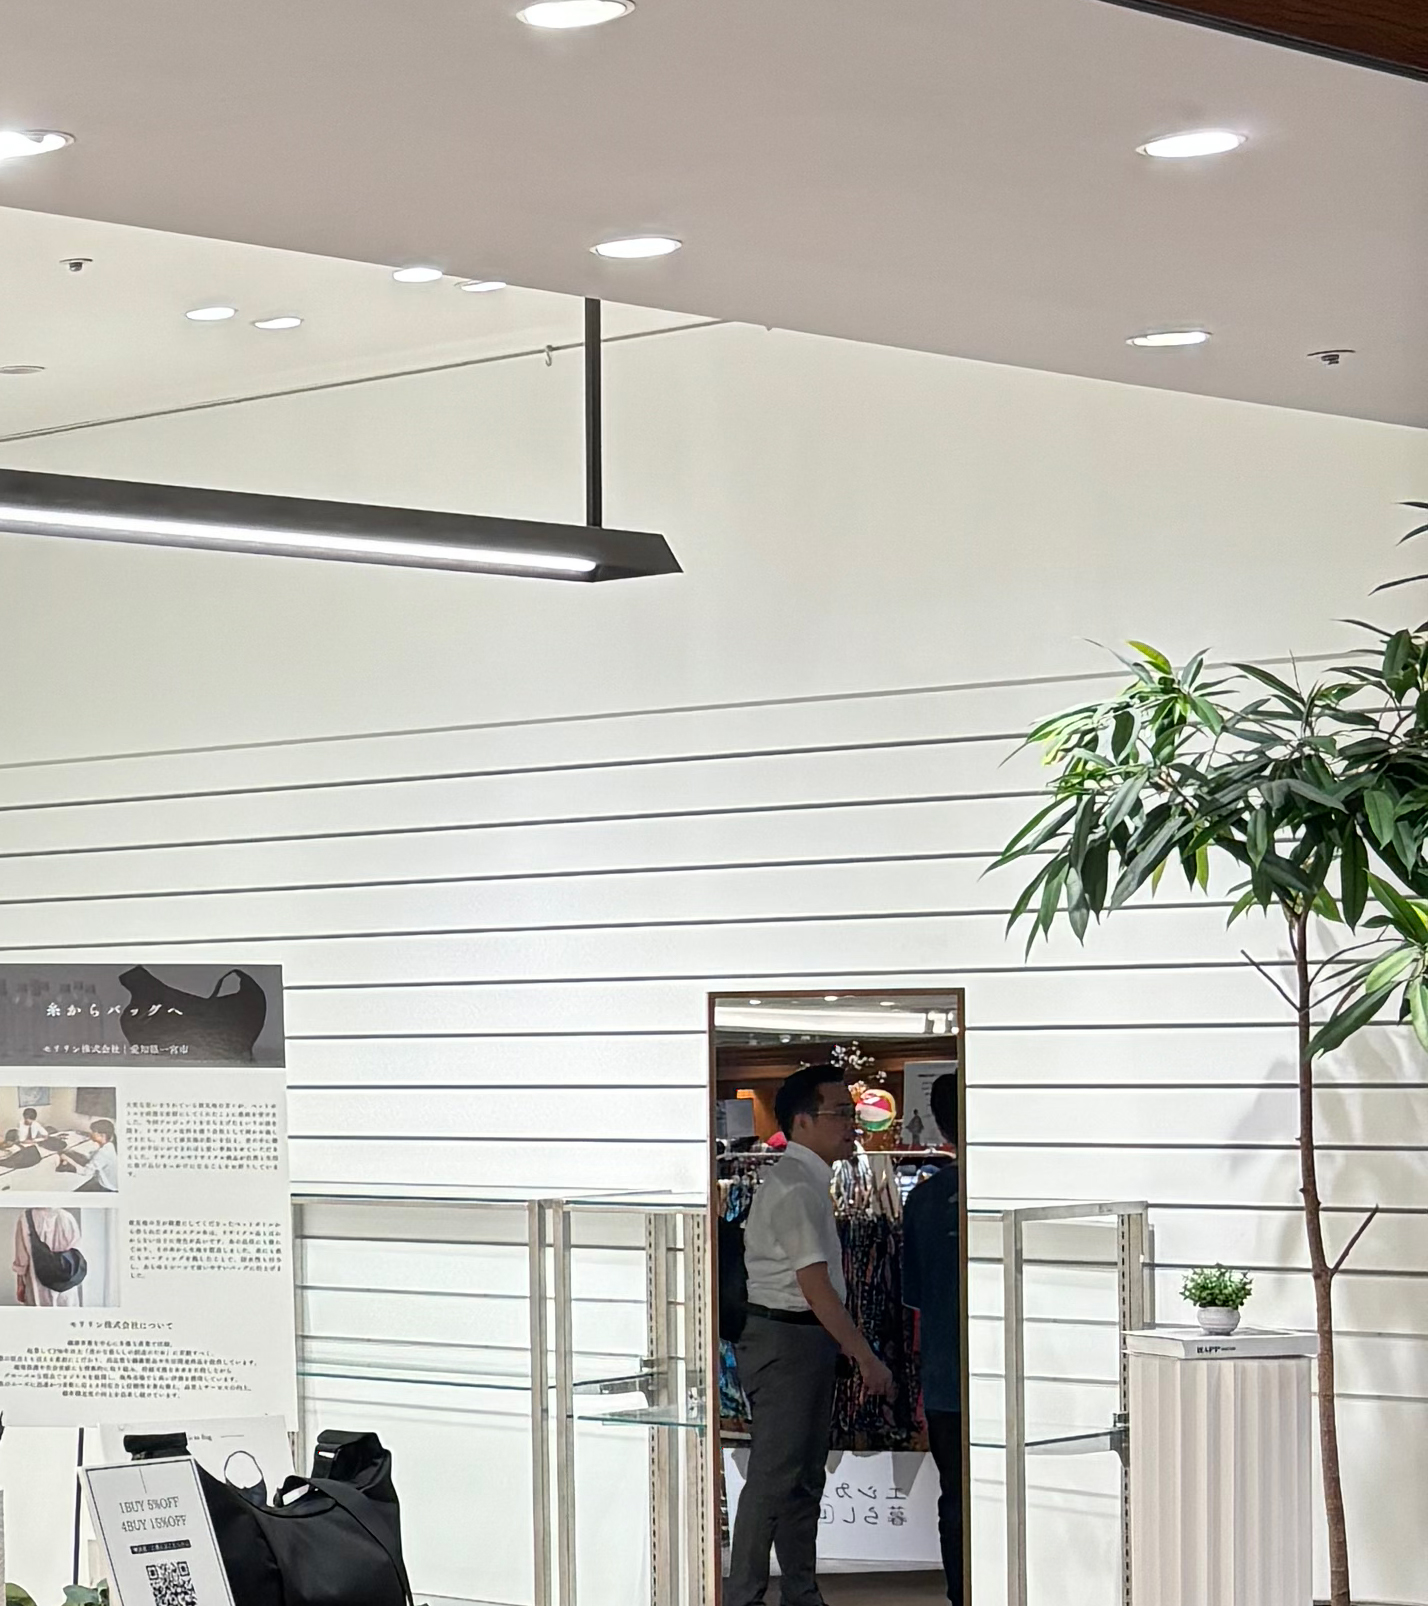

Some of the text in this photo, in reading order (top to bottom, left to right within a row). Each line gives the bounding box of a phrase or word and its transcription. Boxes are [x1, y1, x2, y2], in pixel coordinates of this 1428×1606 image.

[46, 1002, 183, 1017] 糸からバッグへ
[119, 1496, 179, 1513] 1BUY 5%OFF
[121, 1515, 186, 1532] 4BUY 15%OFF
